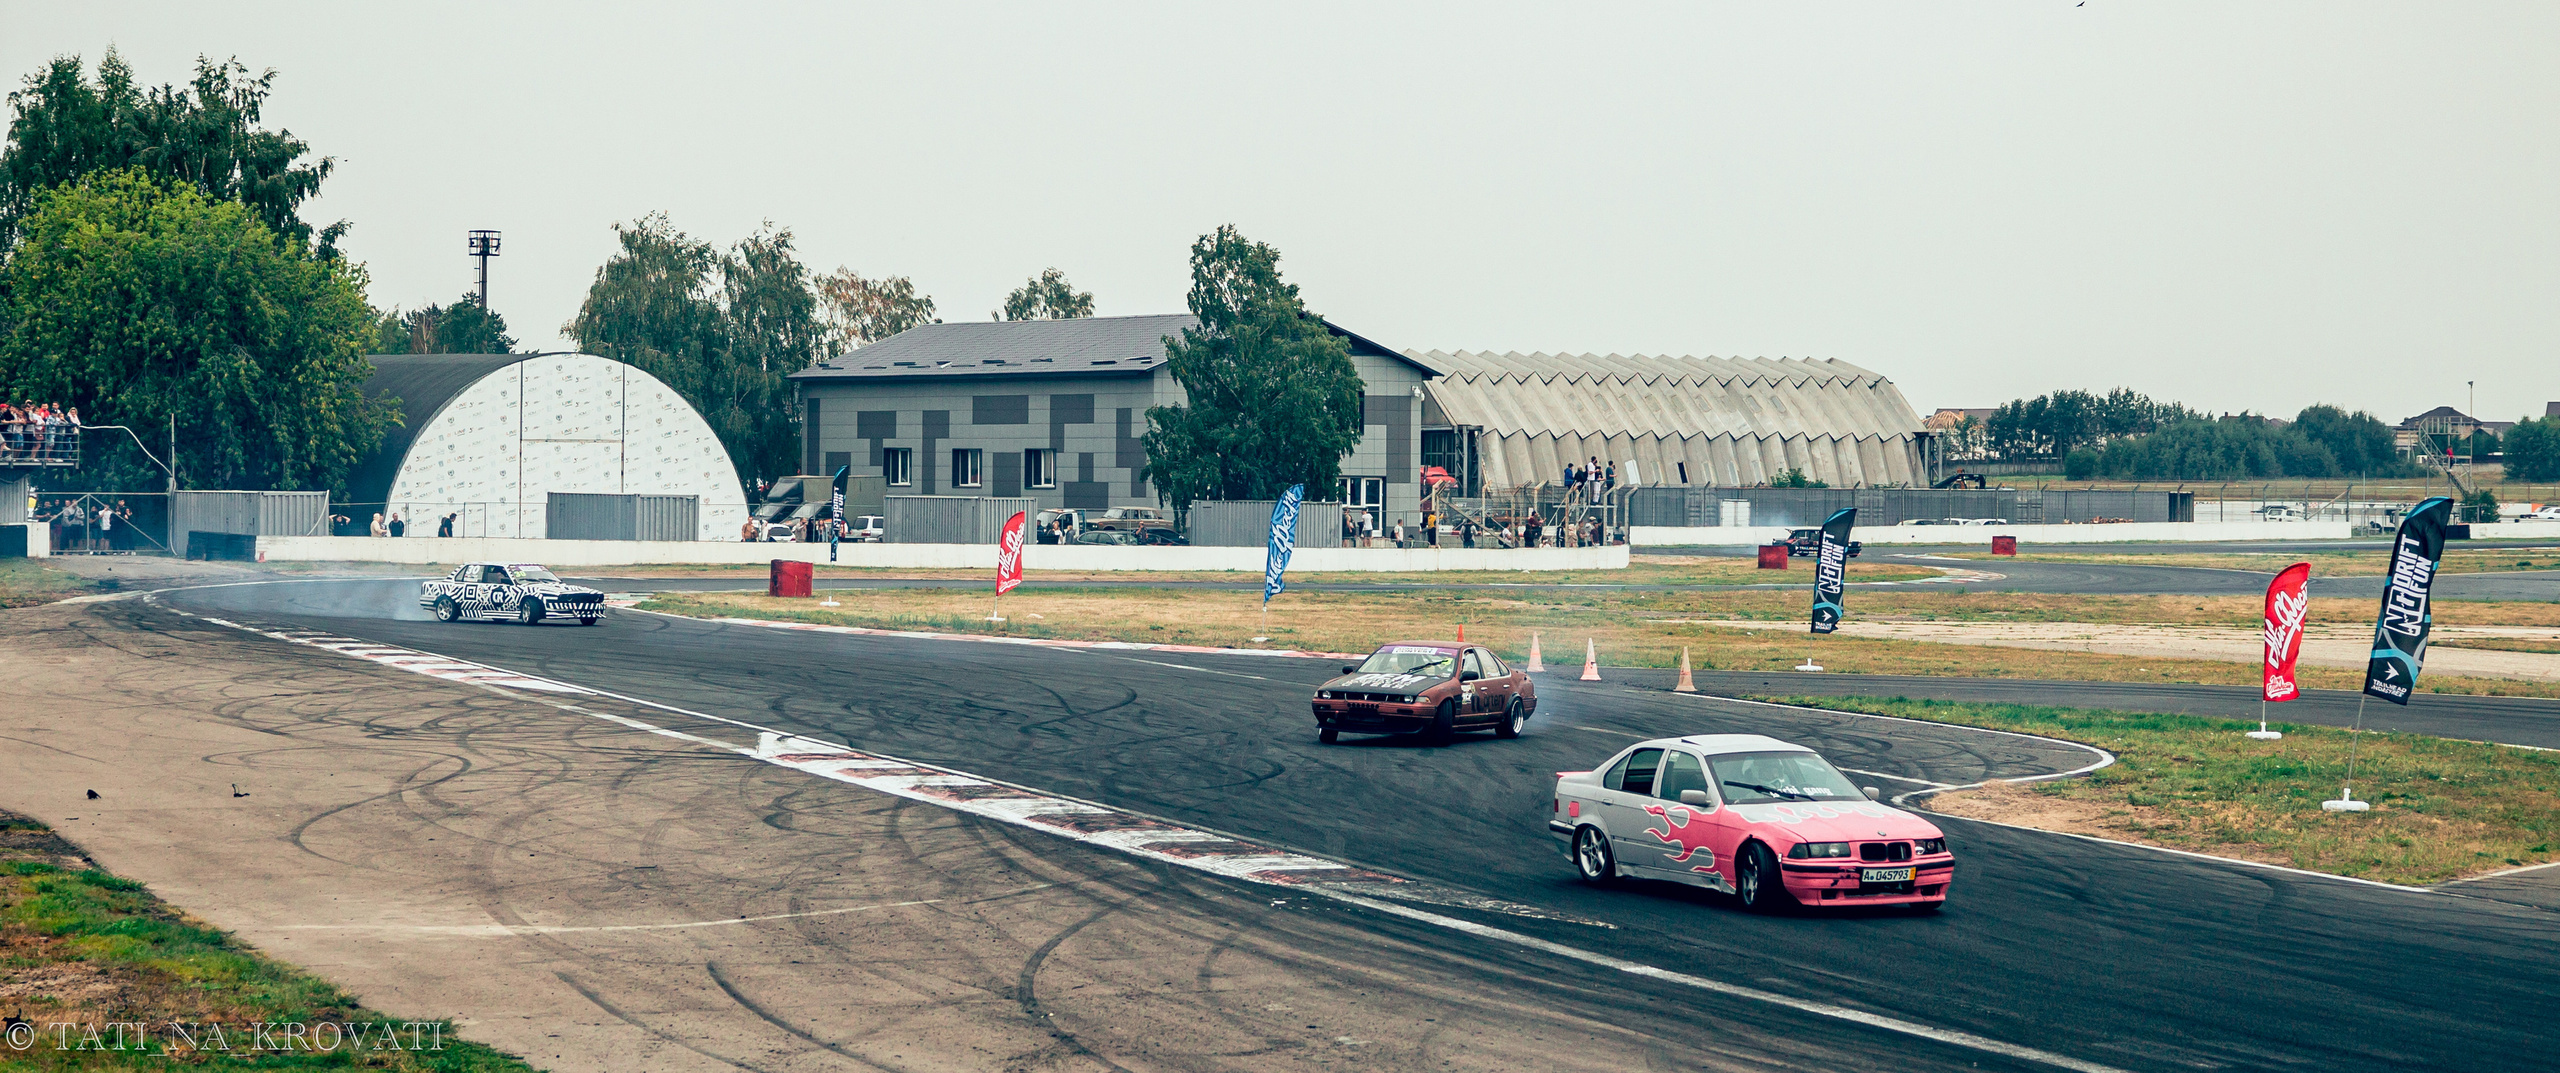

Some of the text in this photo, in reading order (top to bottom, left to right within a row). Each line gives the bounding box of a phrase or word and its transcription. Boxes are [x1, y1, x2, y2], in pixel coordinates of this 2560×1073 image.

[1820, 531, 1835, 565] DRIFT
[1831, 544, 1845, 567] FUN
[466, 565, 480, 575] 30
[2392, 534, 2421, 588] DRIFT
[2411, 555, 2433, 594] FUN
[2373, 679, 2407, 693] TRAILHEAD
[1802, 787, 1834, 796] gang
[1863, 870, 1910, 881] A 045793
